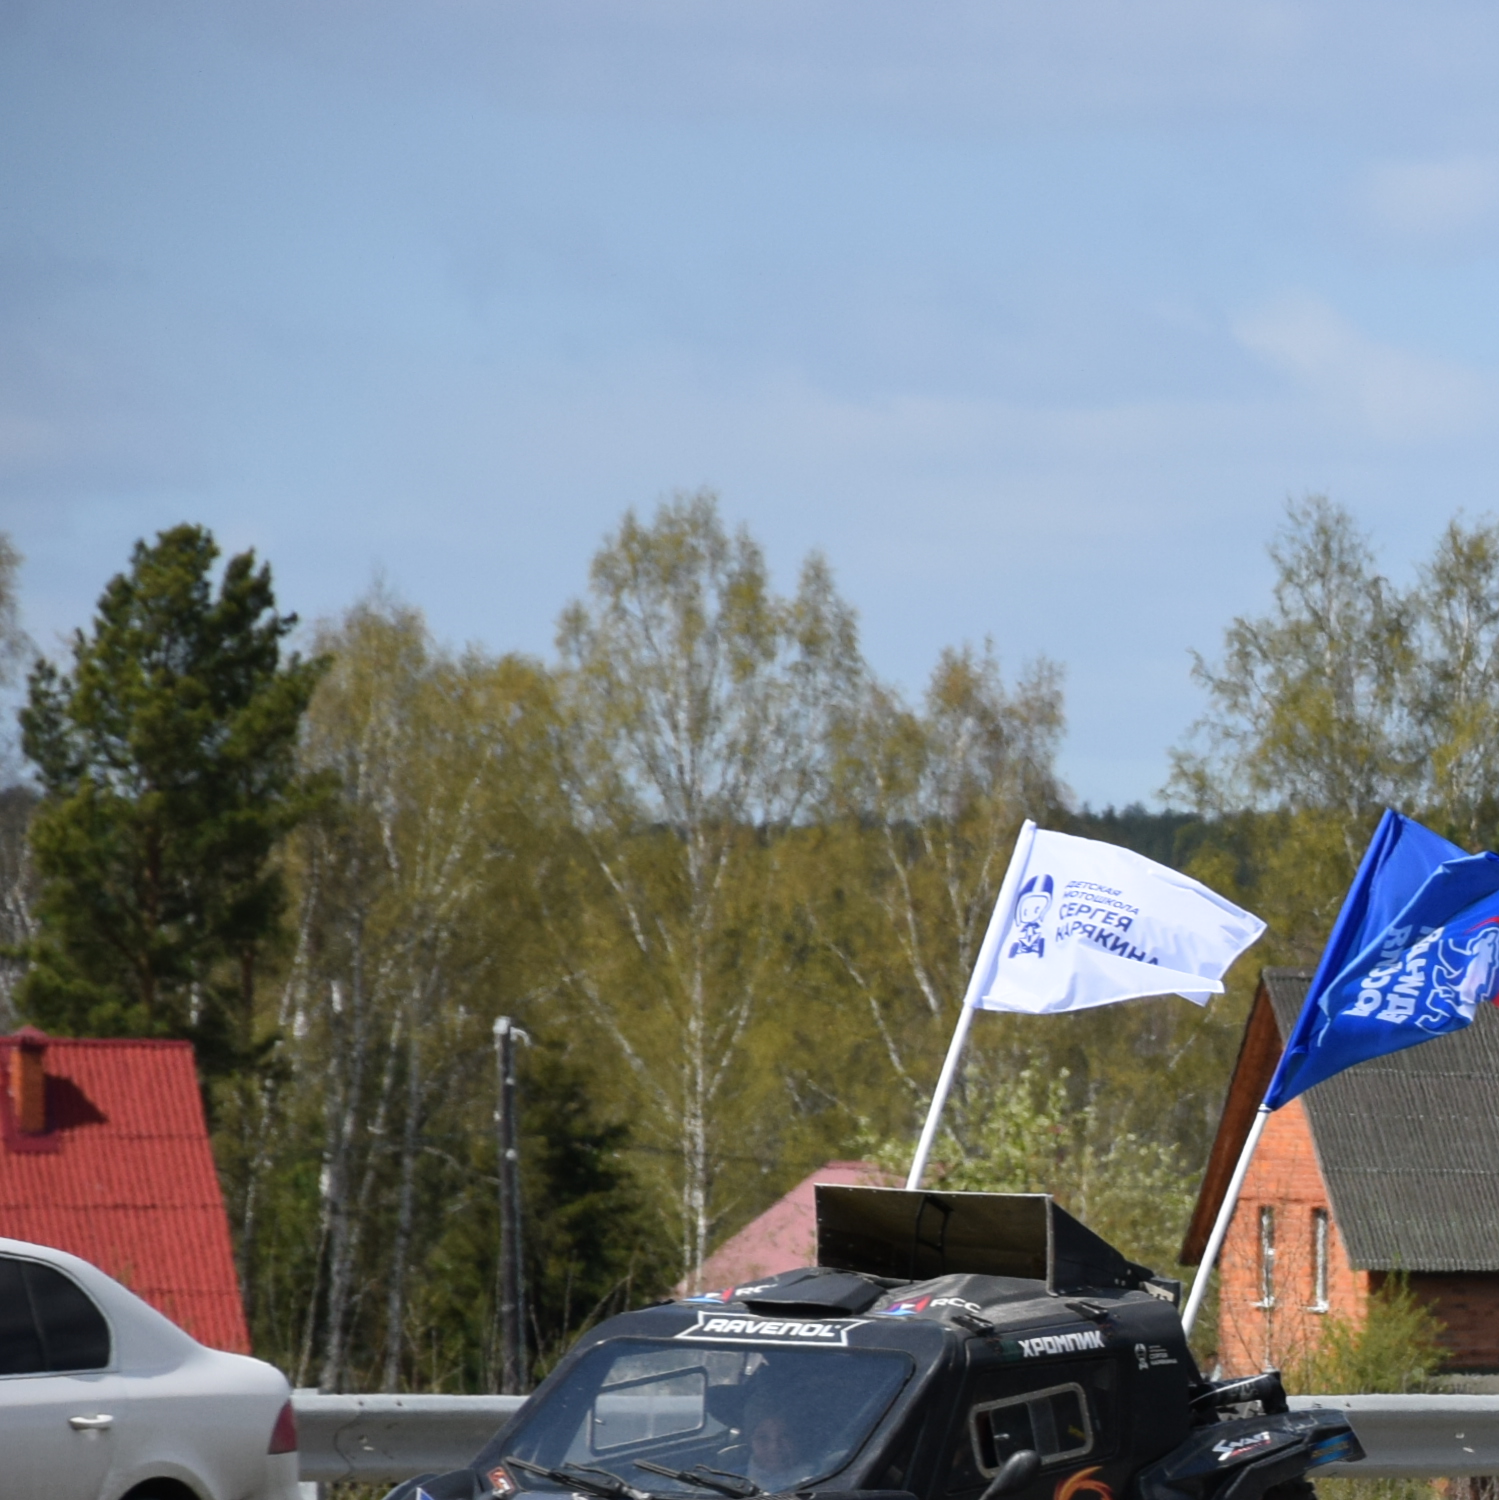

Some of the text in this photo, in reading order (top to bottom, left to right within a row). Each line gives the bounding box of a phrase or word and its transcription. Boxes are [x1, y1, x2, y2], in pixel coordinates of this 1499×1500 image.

[1059, 902, 1133, 933] СЕРГЕЯ
[929, 1297, 981, 1314] RCC
[703, 1318, 838, 1338] RAVENOL
[1017, 1329, 1105, 1359] ХРОМПИК
